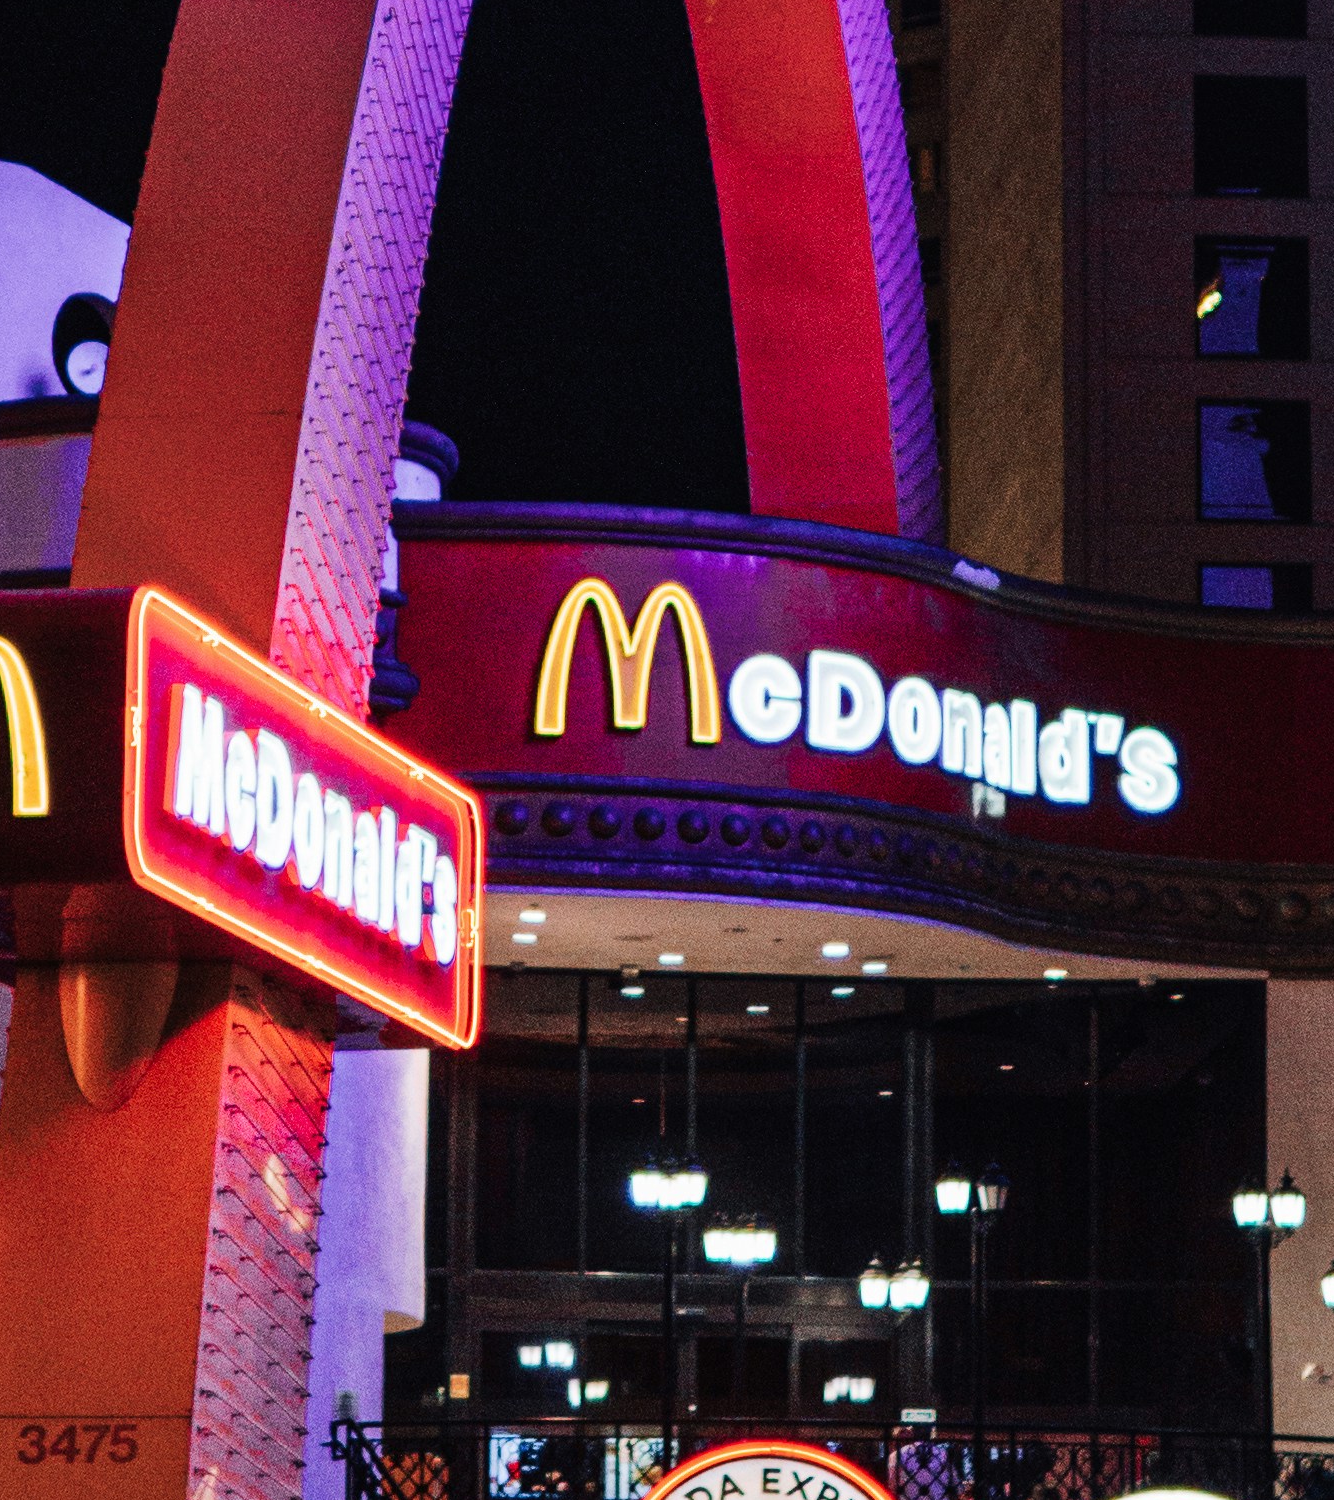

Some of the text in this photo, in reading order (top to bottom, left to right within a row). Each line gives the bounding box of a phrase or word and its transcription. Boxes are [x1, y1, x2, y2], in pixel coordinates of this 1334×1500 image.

[532, 575, 1180, 814] McDonald's
[172, 682, 461, 968] McDonald's
[17, 1425, 139, 1466] 3475
